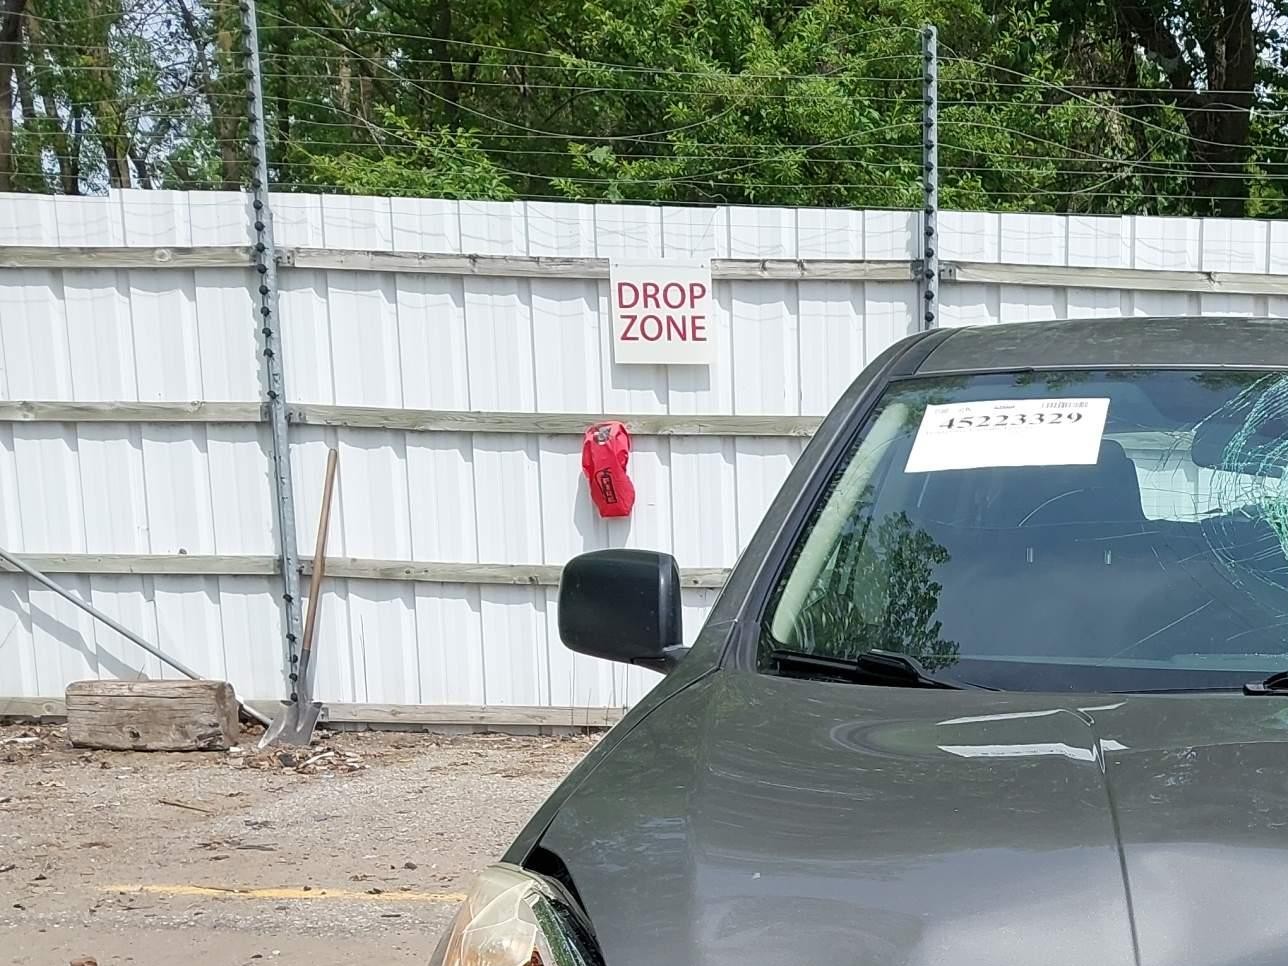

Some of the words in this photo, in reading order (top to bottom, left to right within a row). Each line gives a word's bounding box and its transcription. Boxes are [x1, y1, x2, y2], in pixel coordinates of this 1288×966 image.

[617, 282, 706, 309] DROP
[620, 315, 707, 341] ZONE
[938, 411, 1084, 430] 45223329
